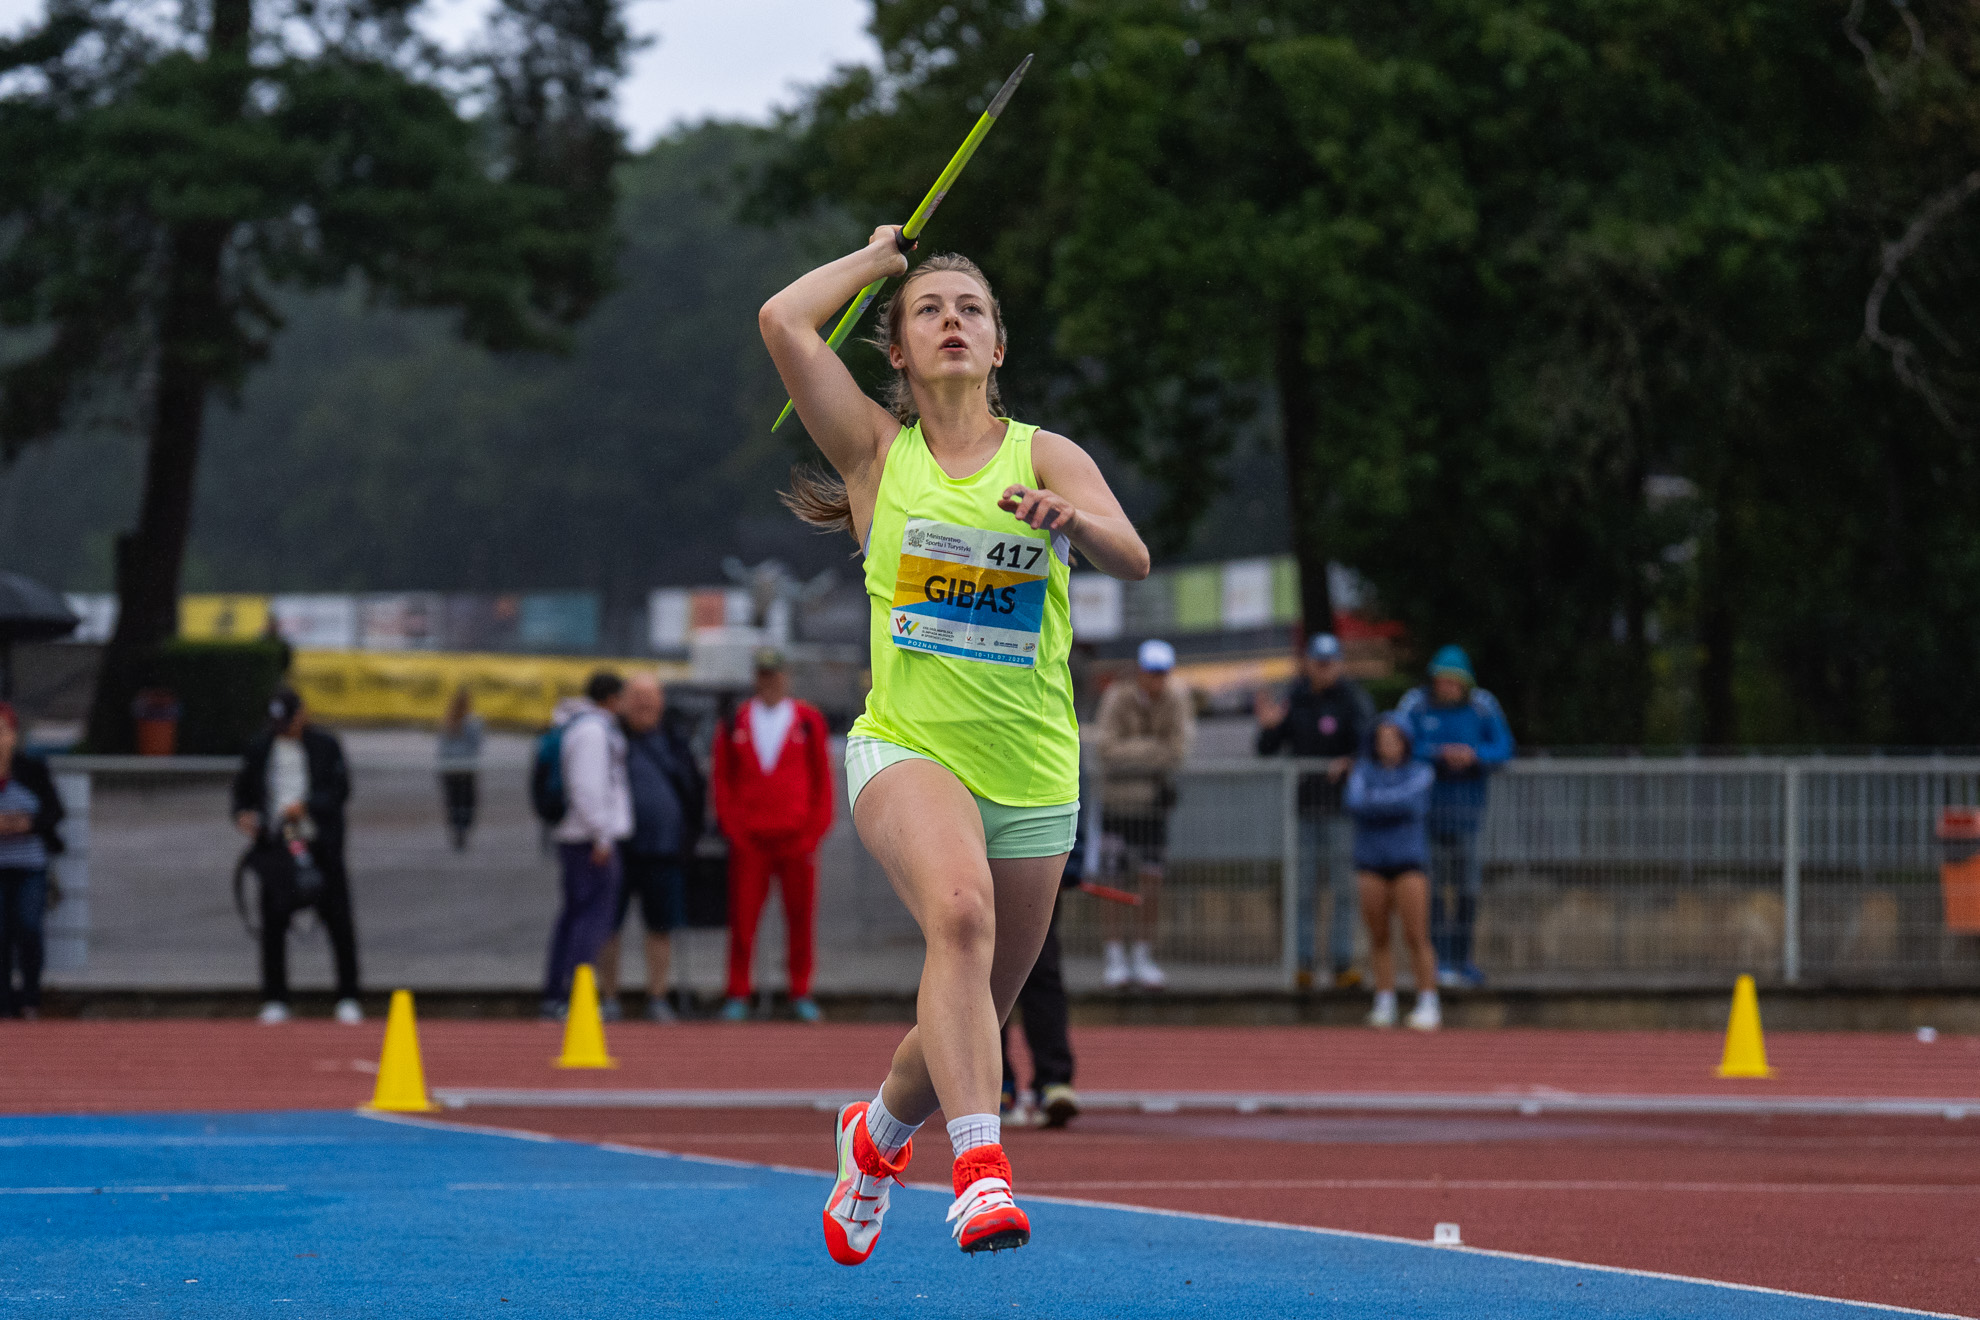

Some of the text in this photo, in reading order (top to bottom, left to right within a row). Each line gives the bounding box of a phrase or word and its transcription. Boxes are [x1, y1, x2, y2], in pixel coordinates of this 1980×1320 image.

[925, 539, 944, 548] Sporty
[947, 542, 972, 552] Turystyki
[986, 541, 1044, 570] 417
[924, 575, 1017, 615] GIBAS
